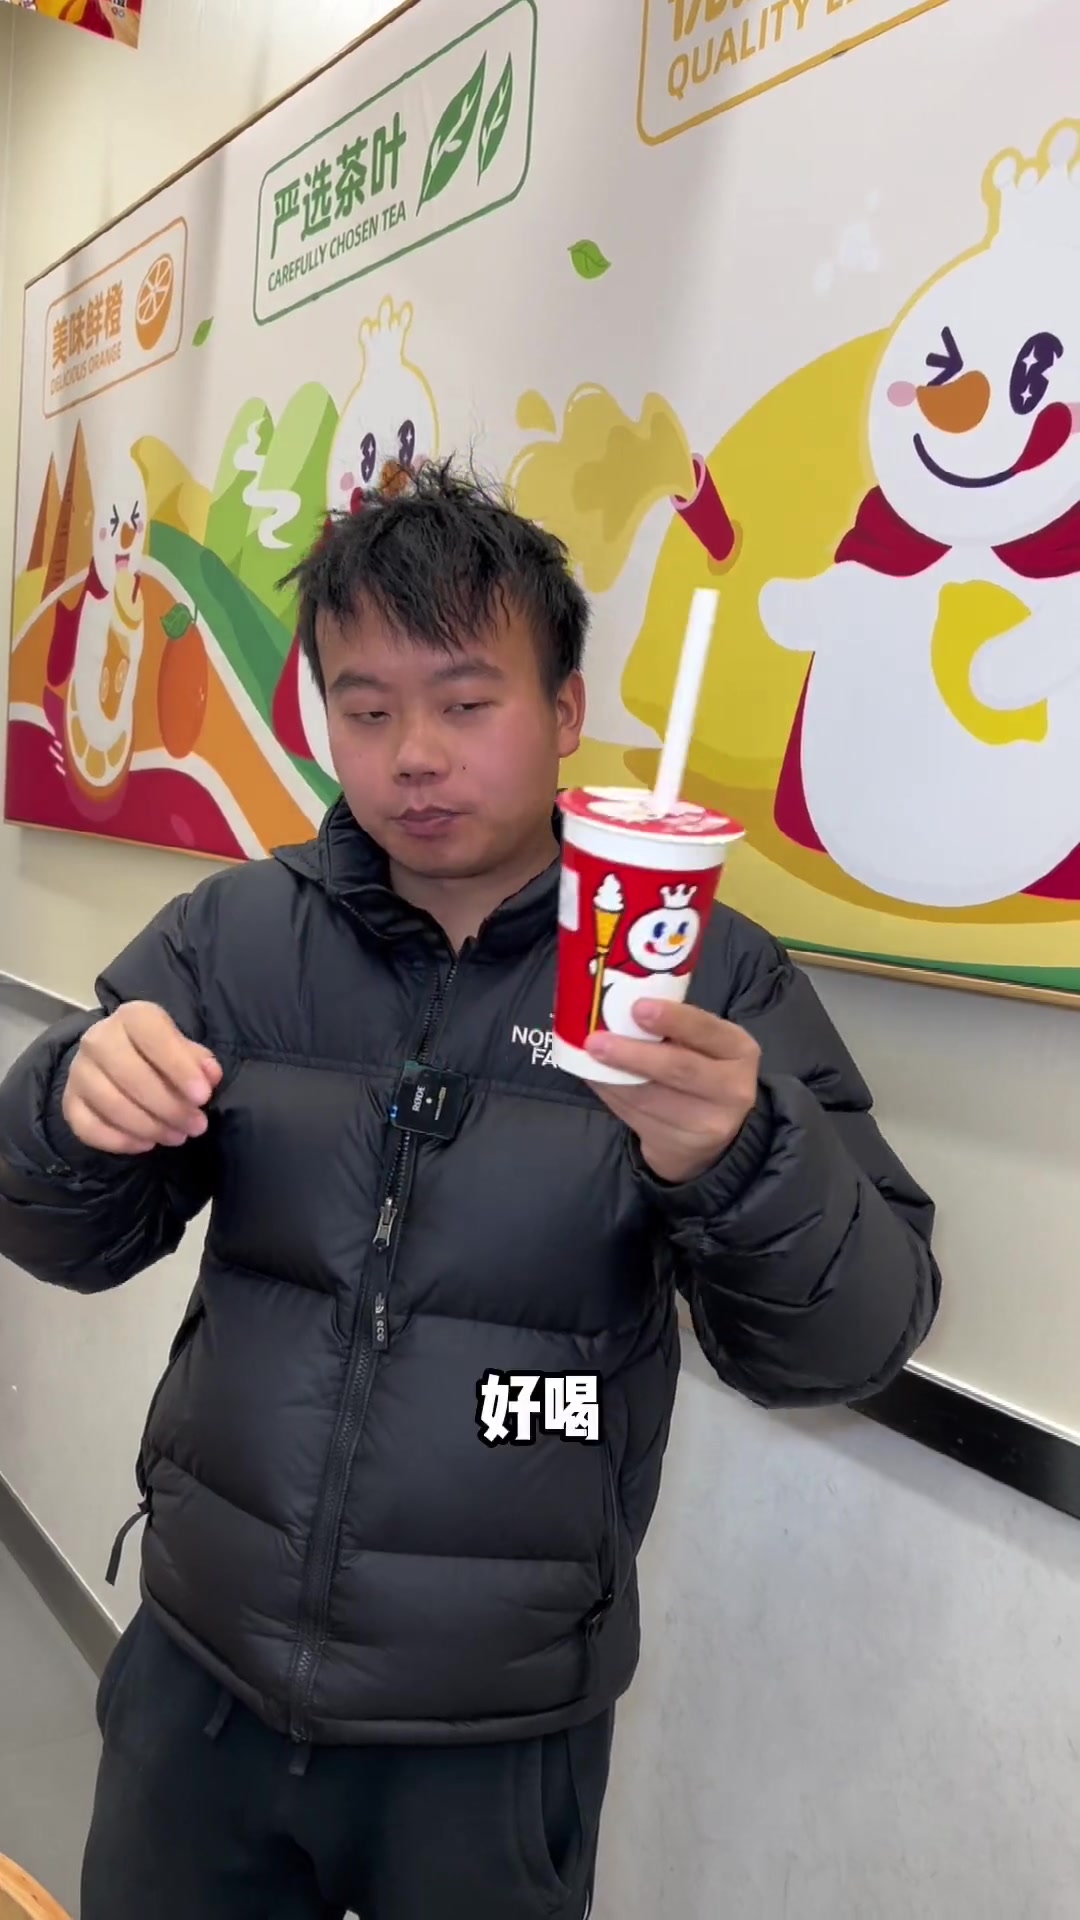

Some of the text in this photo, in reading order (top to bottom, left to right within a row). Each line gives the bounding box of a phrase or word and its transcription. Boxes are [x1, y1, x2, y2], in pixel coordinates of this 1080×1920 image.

[667, 0, 810, 100] QUALITY
[270, 111, 407, 260] 严选茶叶
[267, 200, 407, 292] CAREFULLY CHOSEN TEA
[52, 279, 124, 370] 美味鲜橙
[50, 340, 122, 396] DELICIOUS ORANGE
[511, 1024, 553, 1049] NOR
[531, 1046, 558, 1069] FA
[376, 1320, 386, 1342] eco
